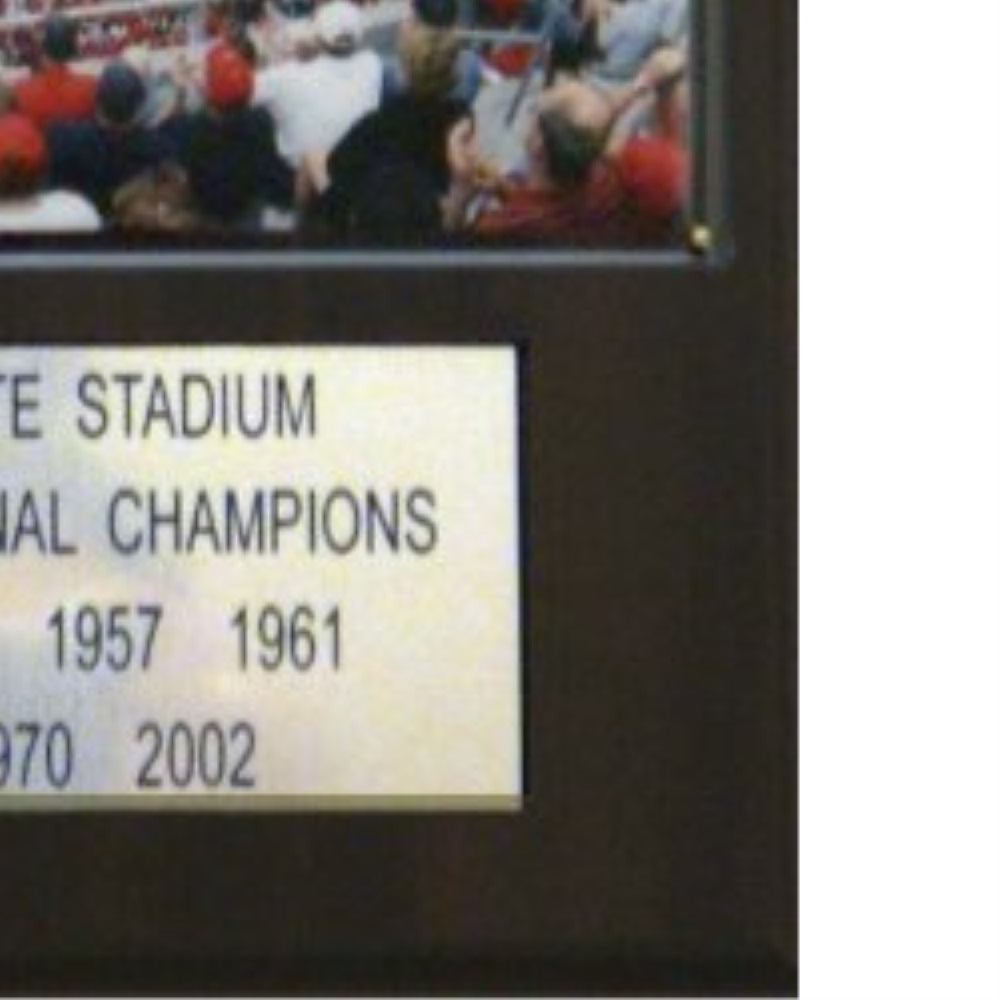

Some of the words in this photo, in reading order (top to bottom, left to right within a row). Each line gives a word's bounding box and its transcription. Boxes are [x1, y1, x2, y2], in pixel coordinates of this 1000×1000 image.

[76, 373, 316, 440] STADIUM
[106, 488, 438, 556] CHAMPIONS
[47, 605, 163, 673] 1957
[231, 606, 342, 672] 1961
[136, 721, 256, 789] 2002
